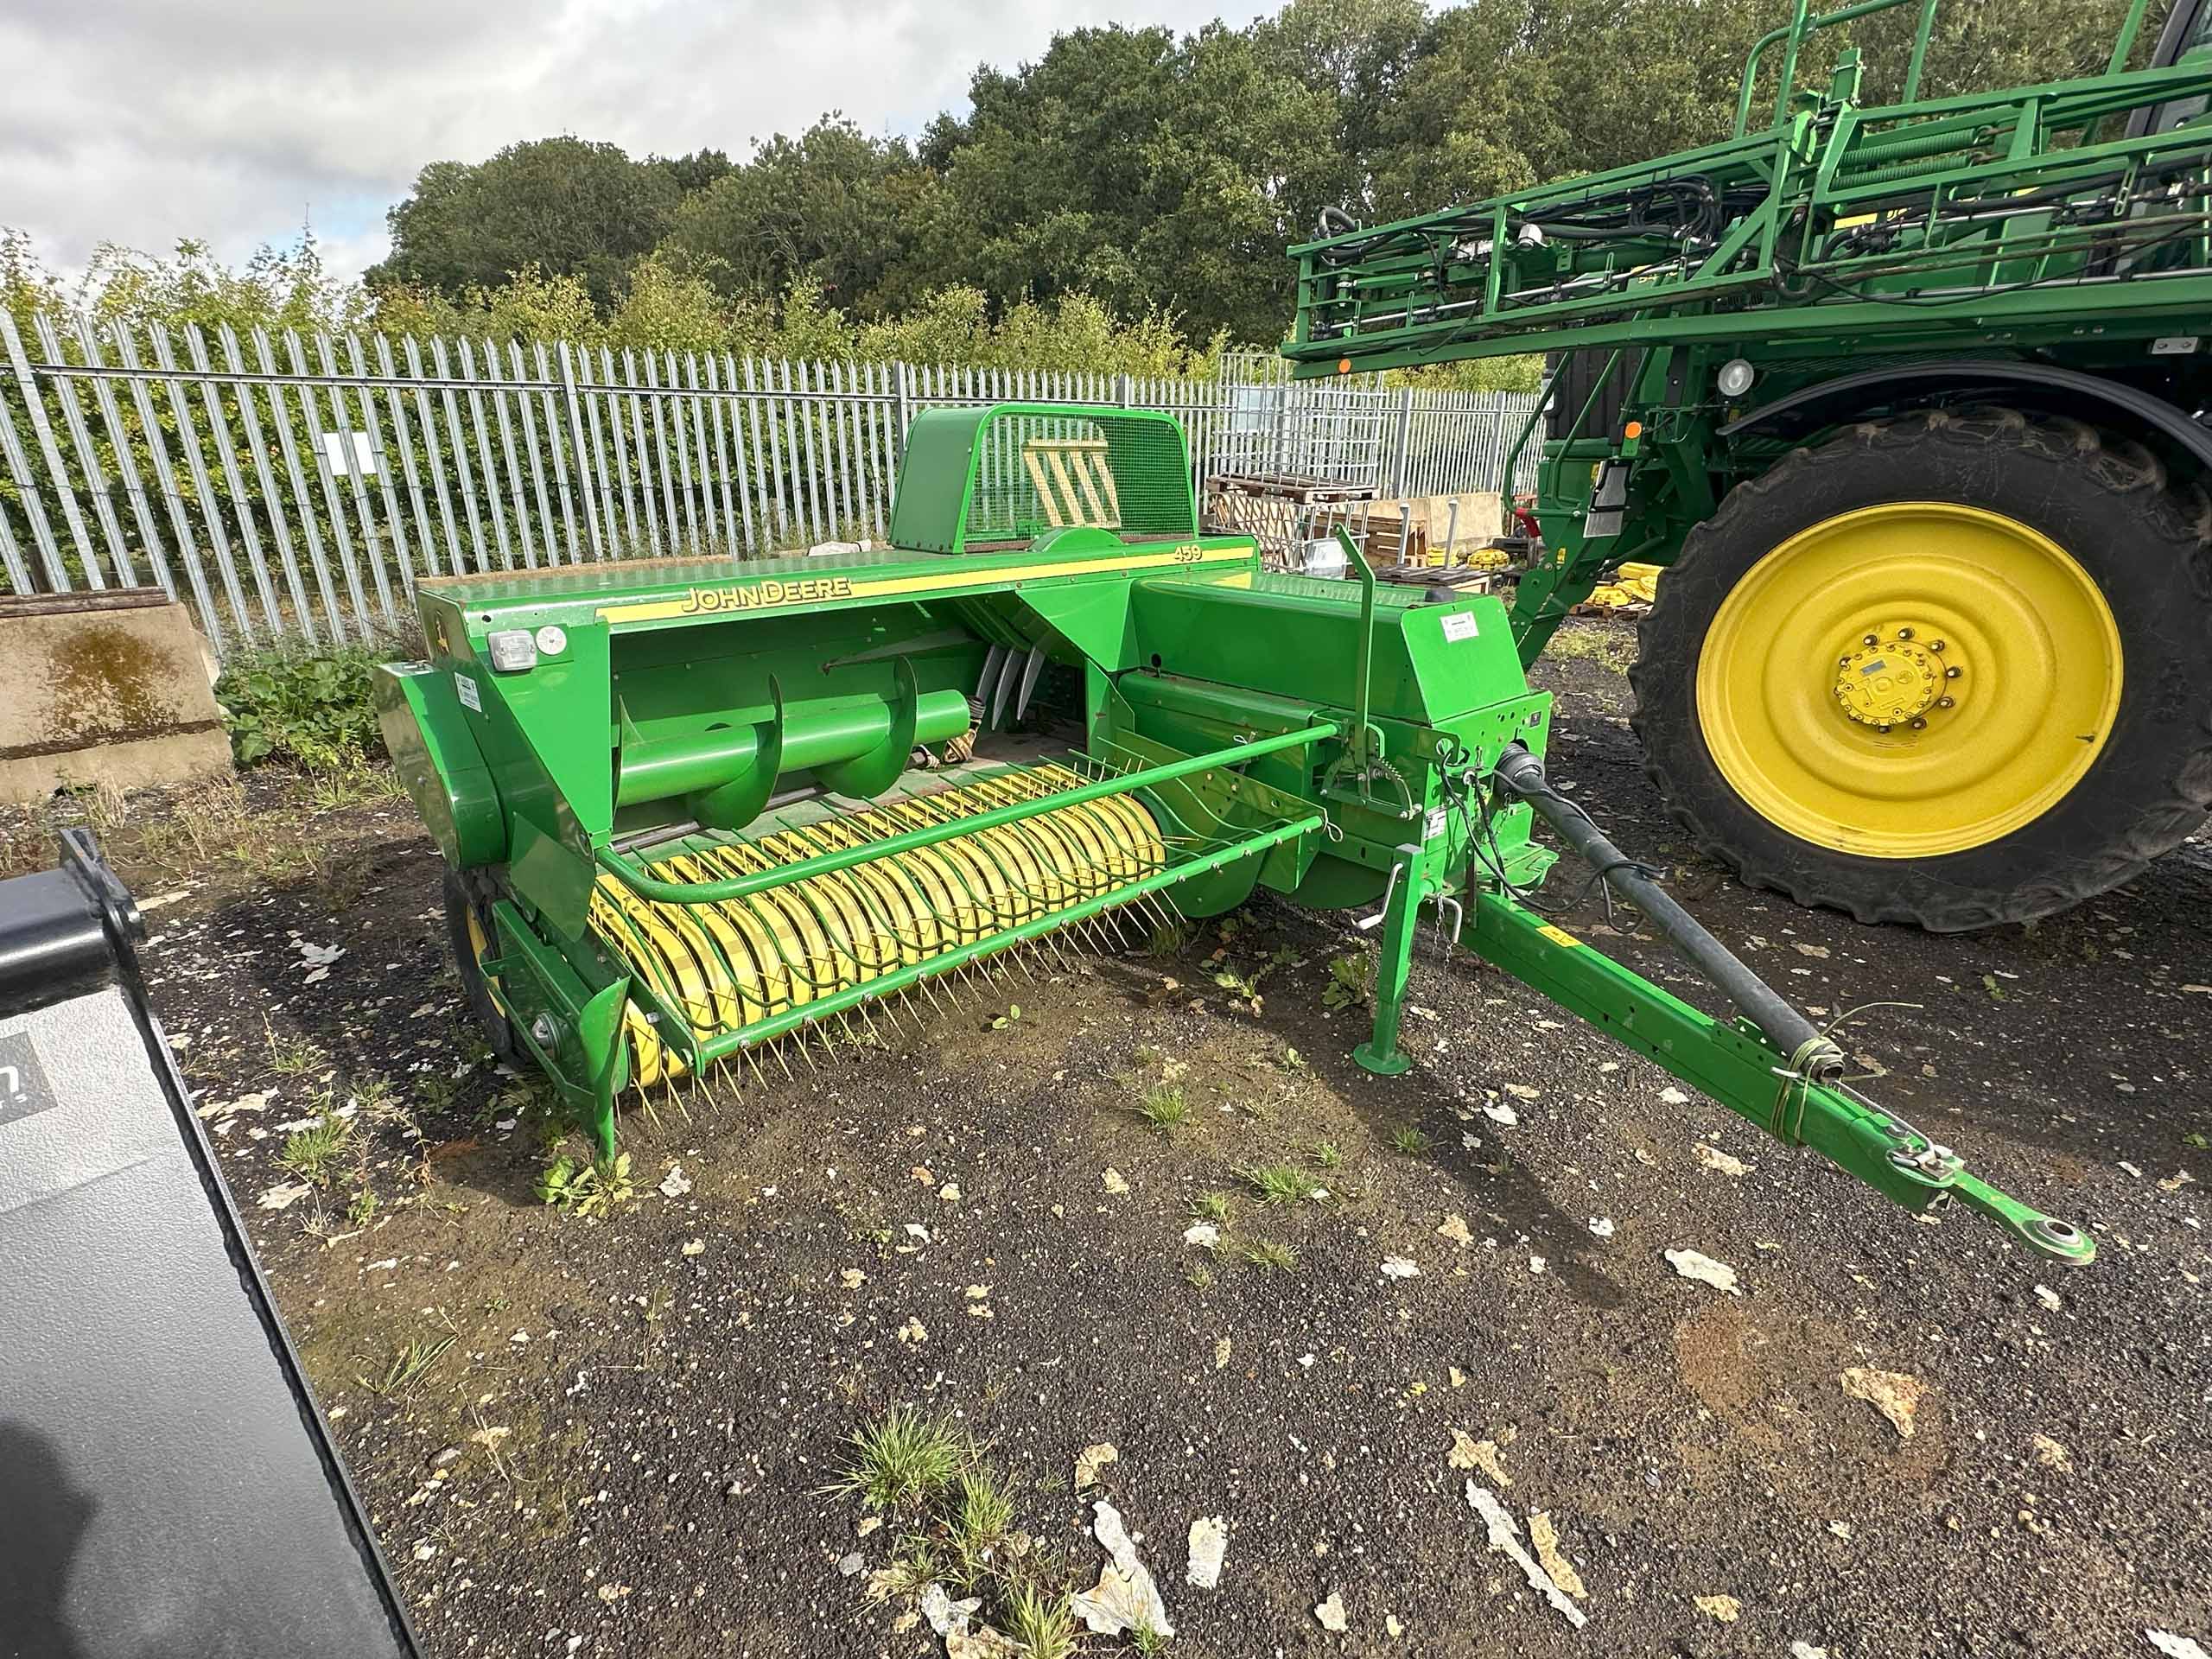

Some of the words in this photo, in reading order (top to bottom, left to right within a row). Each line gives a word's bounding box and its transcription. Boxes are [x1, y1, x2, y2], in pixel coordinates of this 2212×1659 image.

[1175, 545, 1203, 562] 459
[682, 586, 761, 613] JOHN
[760, 577, 852, 604] DEERE
